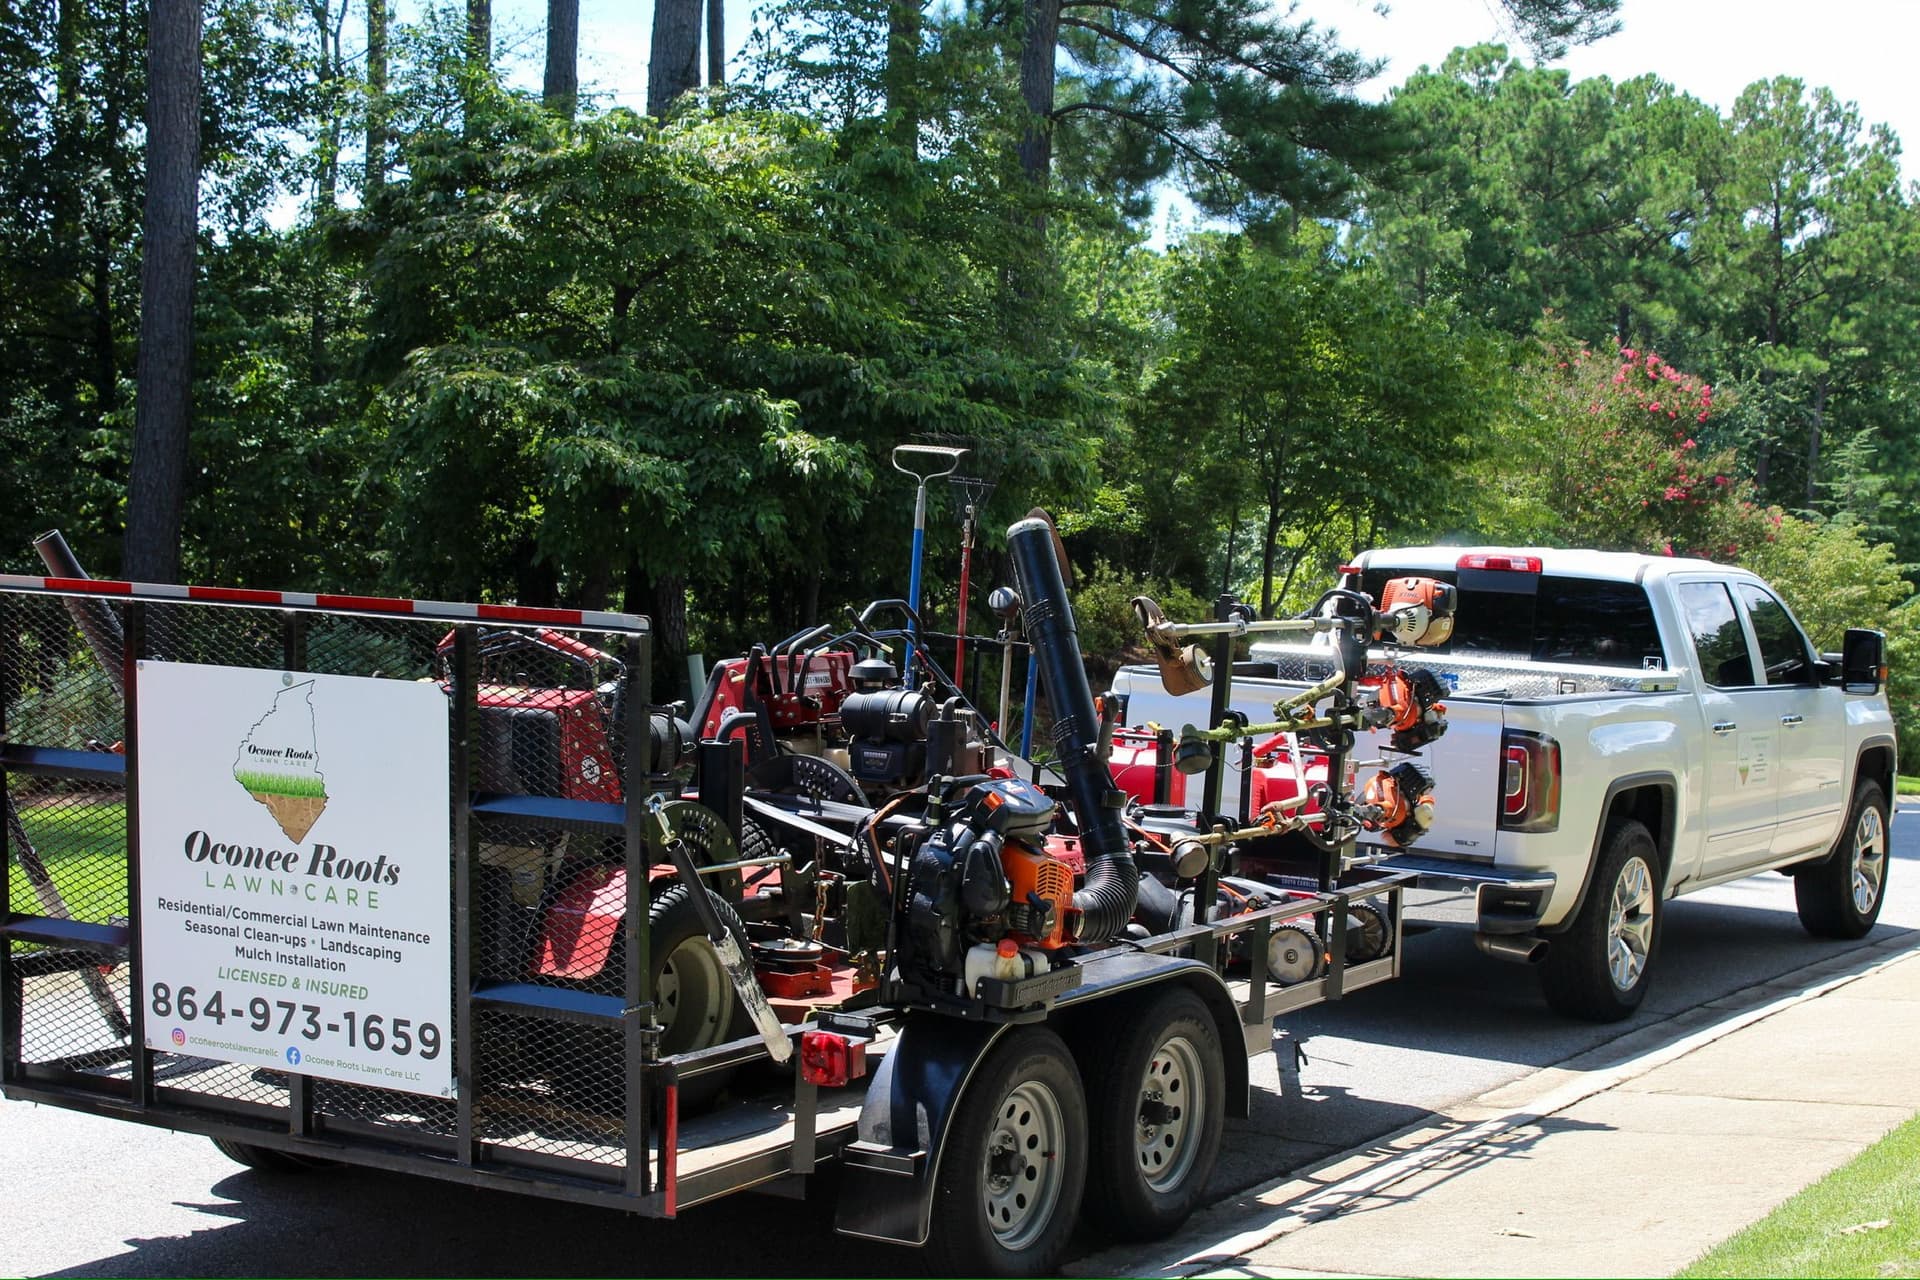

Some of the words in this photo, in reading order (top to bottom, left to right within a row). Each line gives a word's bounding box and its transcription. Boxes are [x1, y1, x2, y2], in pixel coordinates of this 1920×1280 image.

[248, 744, 283, 757] Oconee
[285, 747, 313, 760] Roots
[184, 830, 299, 873] Oconee
[304, 843, 400, 886] Roots
[1454, 839, 1480, 847] SLT
[205, 870, 284, 896] LAWN
[304, 883, 379, 909] CARE
[158, 897, 307, 928] Residential/Commercial
[312, 917, 345, 933] Lawn
[349, 922, 430, 944] Maintenance
[185, 920, 240, 938] Seasonal
[244, 927, 307, 949] Clean-ups
[320, 937, 402, 963] Landscaping
[235, 945, 272, 962] Mulch
[276, 952, 346, 972] Installation
[217, 966, 287, 988] LICENSED
[291, 977, 301, 990] &
[305, 979, 369, 1000] INSURED
[152, 982, 441, 1060] 864-973-1659
[304, 1054, 335, 1067] Oconee
[336, 1060, 359, 1071] Roots
[361, 1064, 383, 1075] Lawn
[384, 1067, 403, 1078] Care
[405, 1071, 420, 1081] LLC
